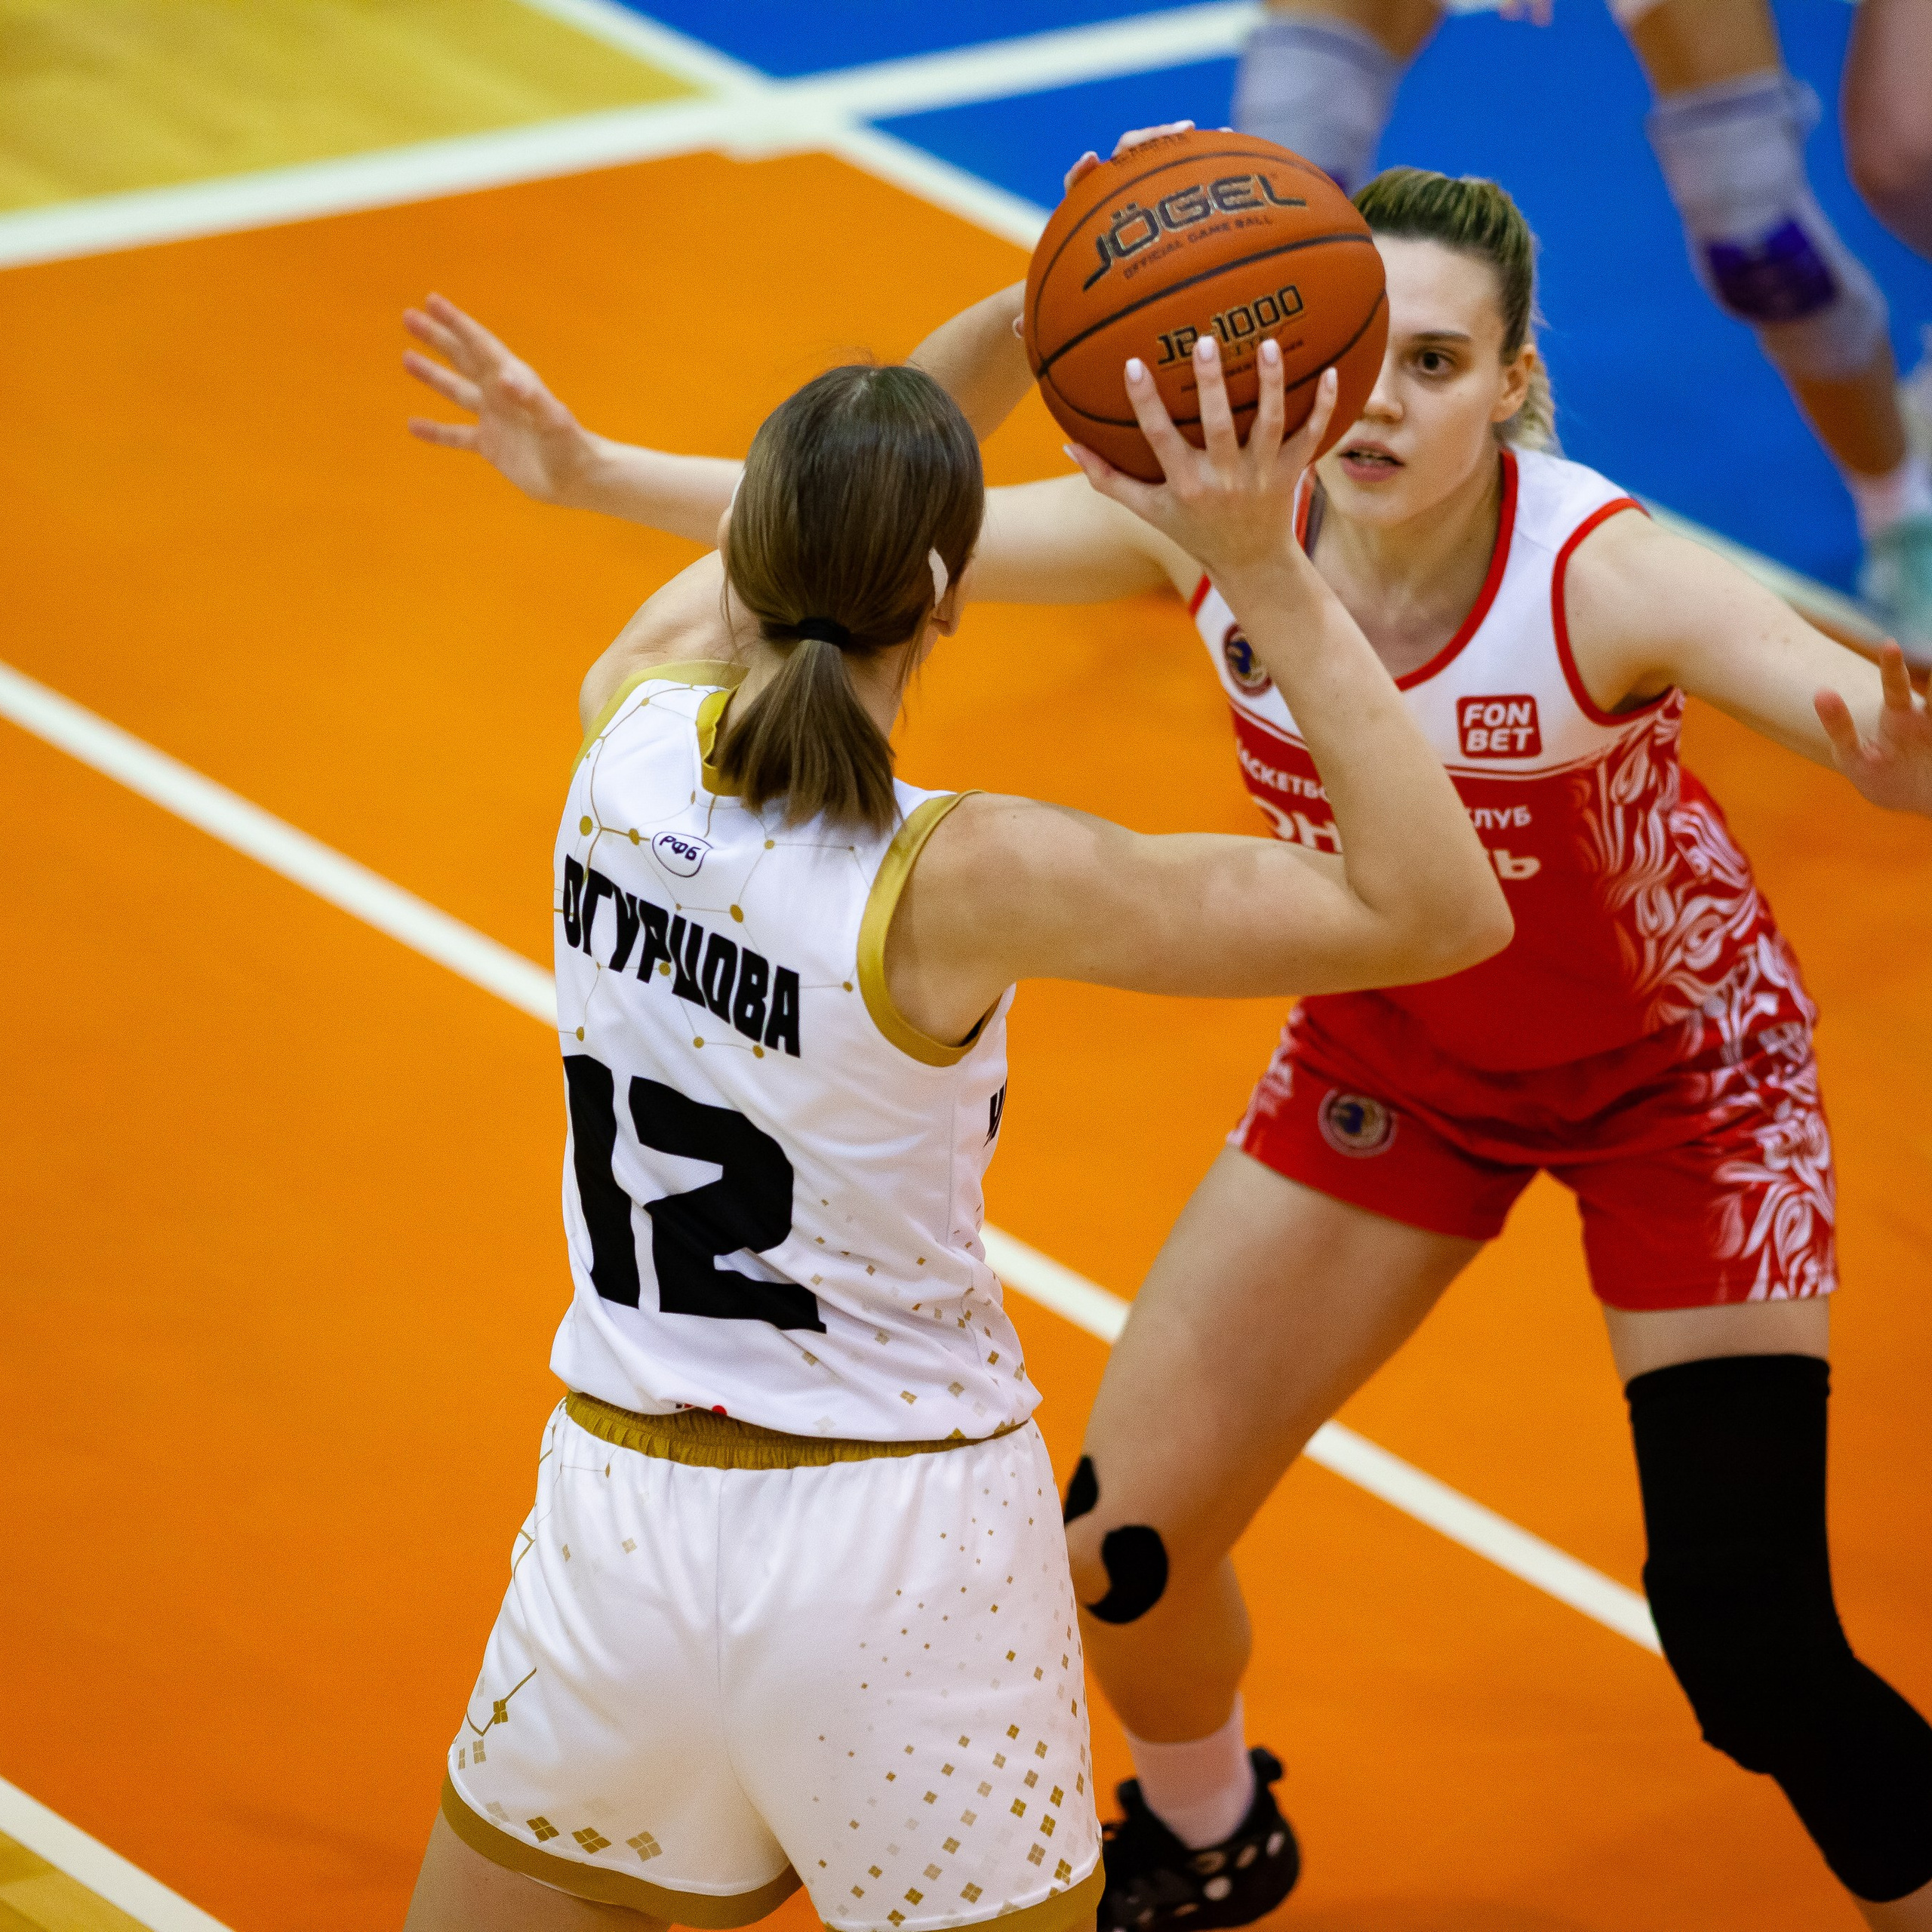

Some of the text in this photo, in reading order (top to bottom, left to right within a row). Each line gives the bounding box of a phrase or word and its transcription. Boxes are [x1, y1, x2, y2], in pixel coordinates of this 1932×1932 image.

[1083, 173, 1309, 293] JÖGEL
[1187, 221, 1230, 244] GAME
[1157, 283, 1305, 366] JB1000
[1463, 701, 1531, 728] FON
[1466, 727, 1534, 752] BET
[1465, 804, 1532, 829] ЛУБ
[659, 835, 702, 862] РФБ
[562, 854, 801, 1058] ОГУРЦОВА
[561, 1054, 827, 1334] 12
